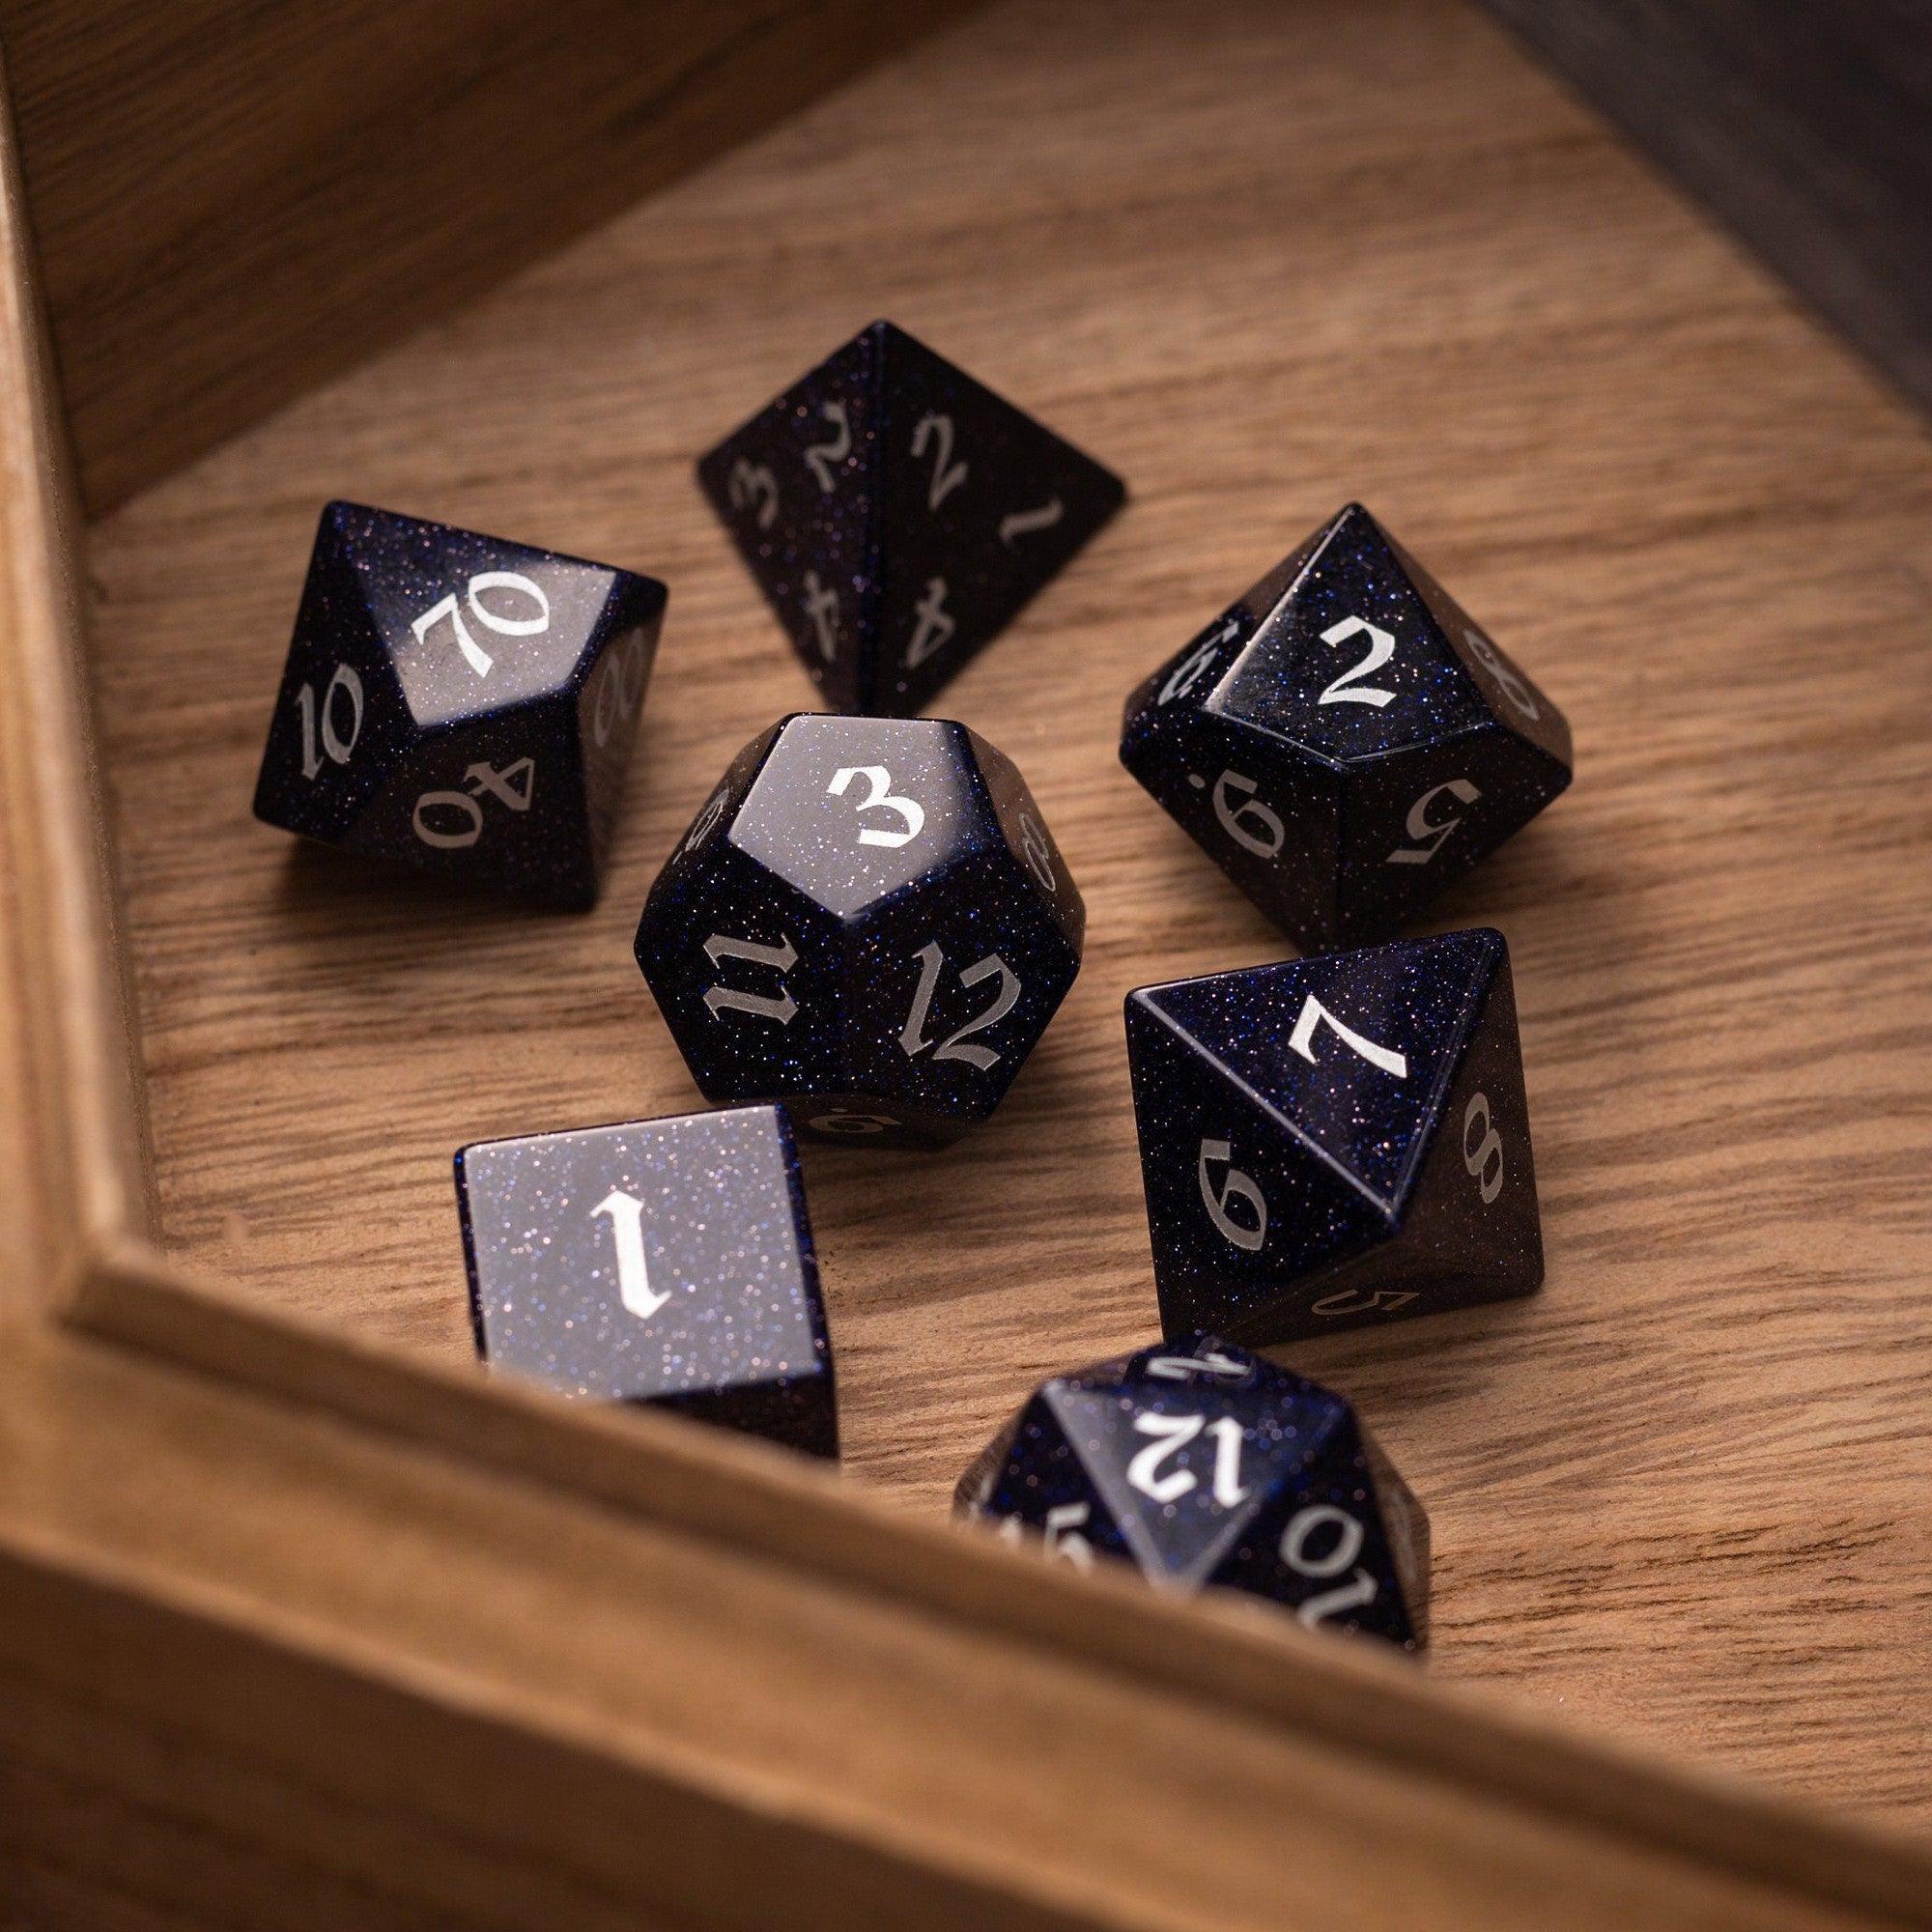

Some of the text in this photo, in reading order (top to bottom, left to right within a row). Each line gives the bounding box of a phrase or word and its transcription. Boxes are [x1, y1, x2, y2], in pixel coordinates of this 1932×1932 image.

[728, 458, 779, 528] 3
[805, 401, 852, 492] 2
[911, 414, 967, 511] 2
[999, 498, 1064, 547] 1
[411, 570, 550, 678] 70
[803, 571, 838, 663] 4
[906, 580, 955, 668] 4
[1318, 615, 1397, 707] 2
[295, 663, 363, 781] 10
[1462, 629, 1539, 722] 8
[412, 756, 534, 849] 40
[826, 765, 924, 848] 3
[1385, 779, 1481, 865] 5
[702, 932, 799, 1027] 11
[897, 940, 1022, 1071] 12
[1288, 994, 1407, 1079] 7
[1199, 1138, 1267, 1251] 6
[1463, 1092, 1503, 1205] 8
[590, 1190, 672, 1320] 1
[1311, 1290, 1420, 1316] 5
[1126, 1410, 1250, 1507] 12
